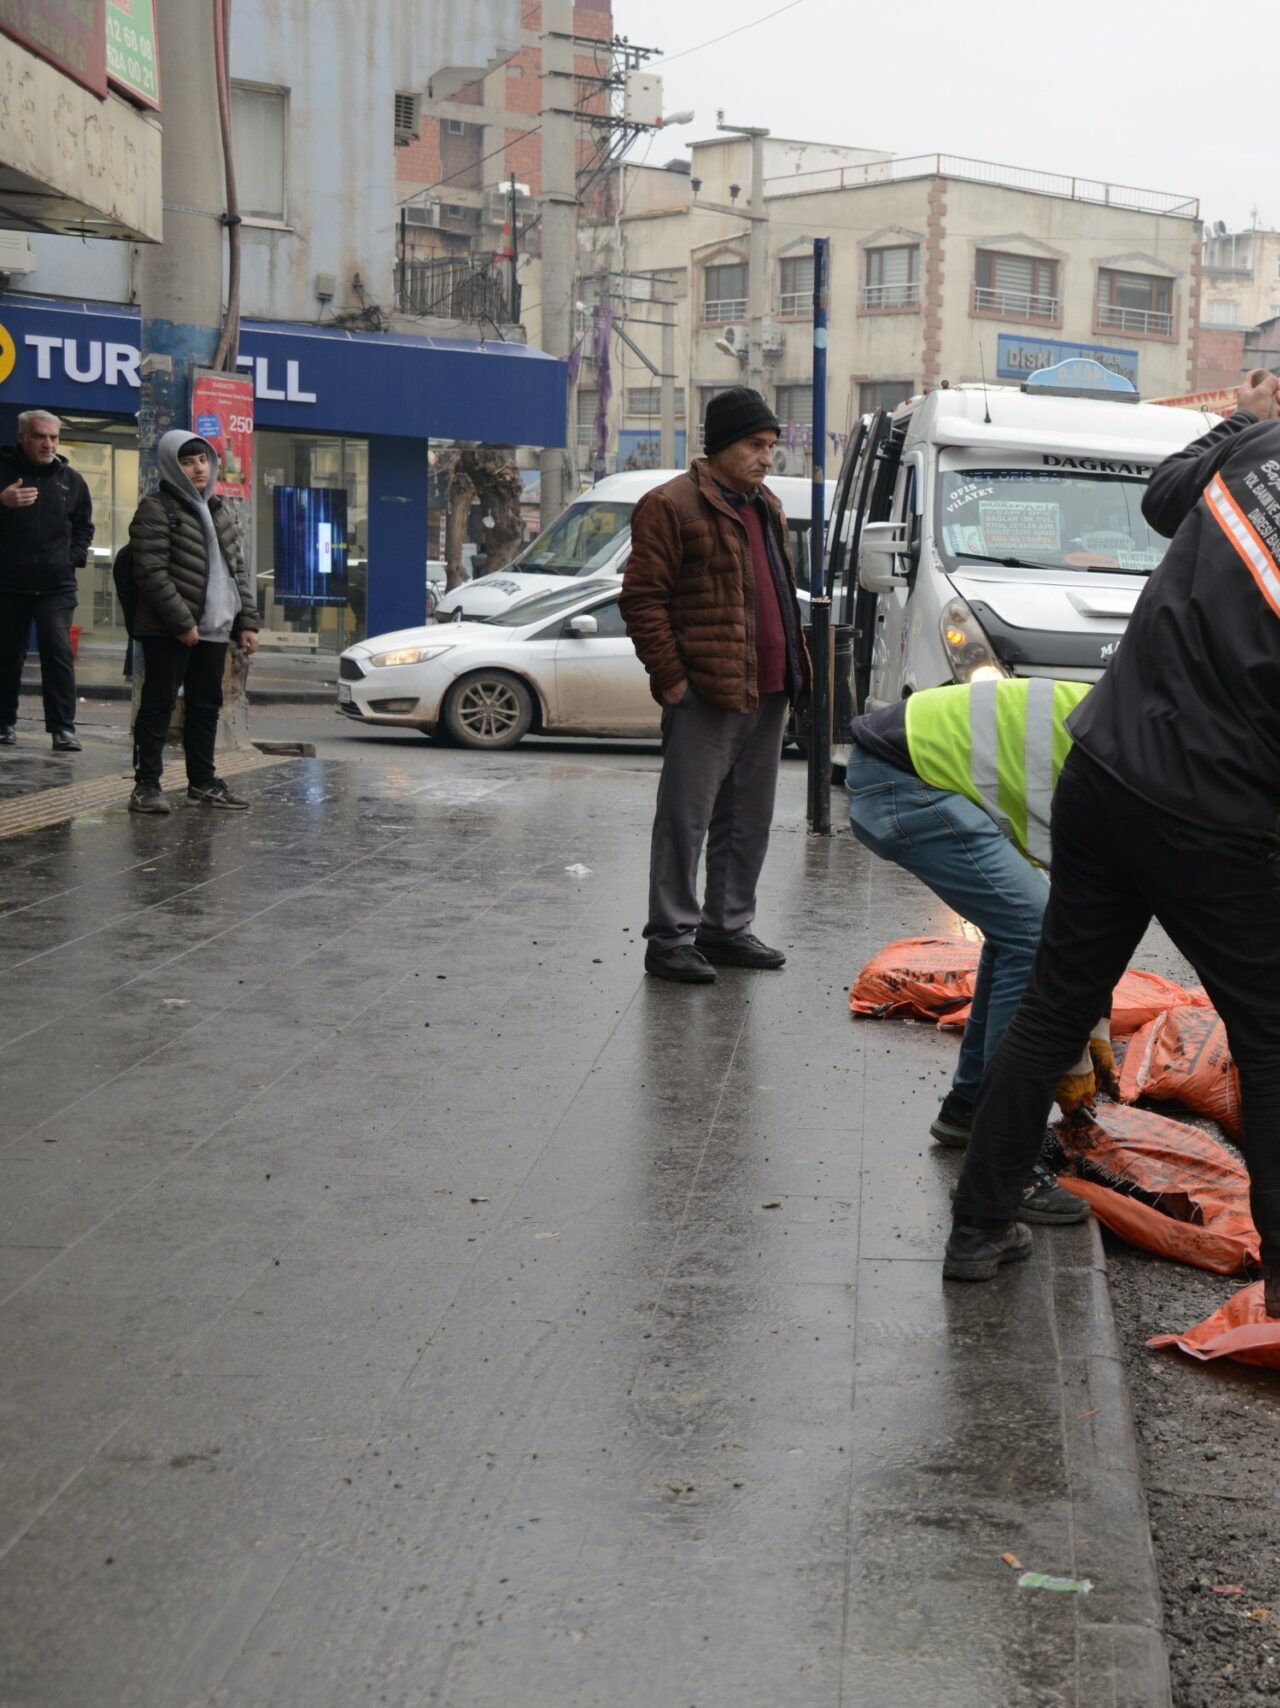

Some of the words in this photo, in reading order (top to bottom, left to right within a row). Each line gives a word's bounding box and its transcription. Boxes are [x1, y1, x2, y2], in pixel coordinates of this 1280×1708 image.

[229, 414, 253, 434] 250
[1243, 471, 1259, 489] YOL
[1252, 483, 1276, 507] BAKIM
[1266, 499, 1280, 516] VE
[1247, 508, 1277, 539] DAİRESİ
